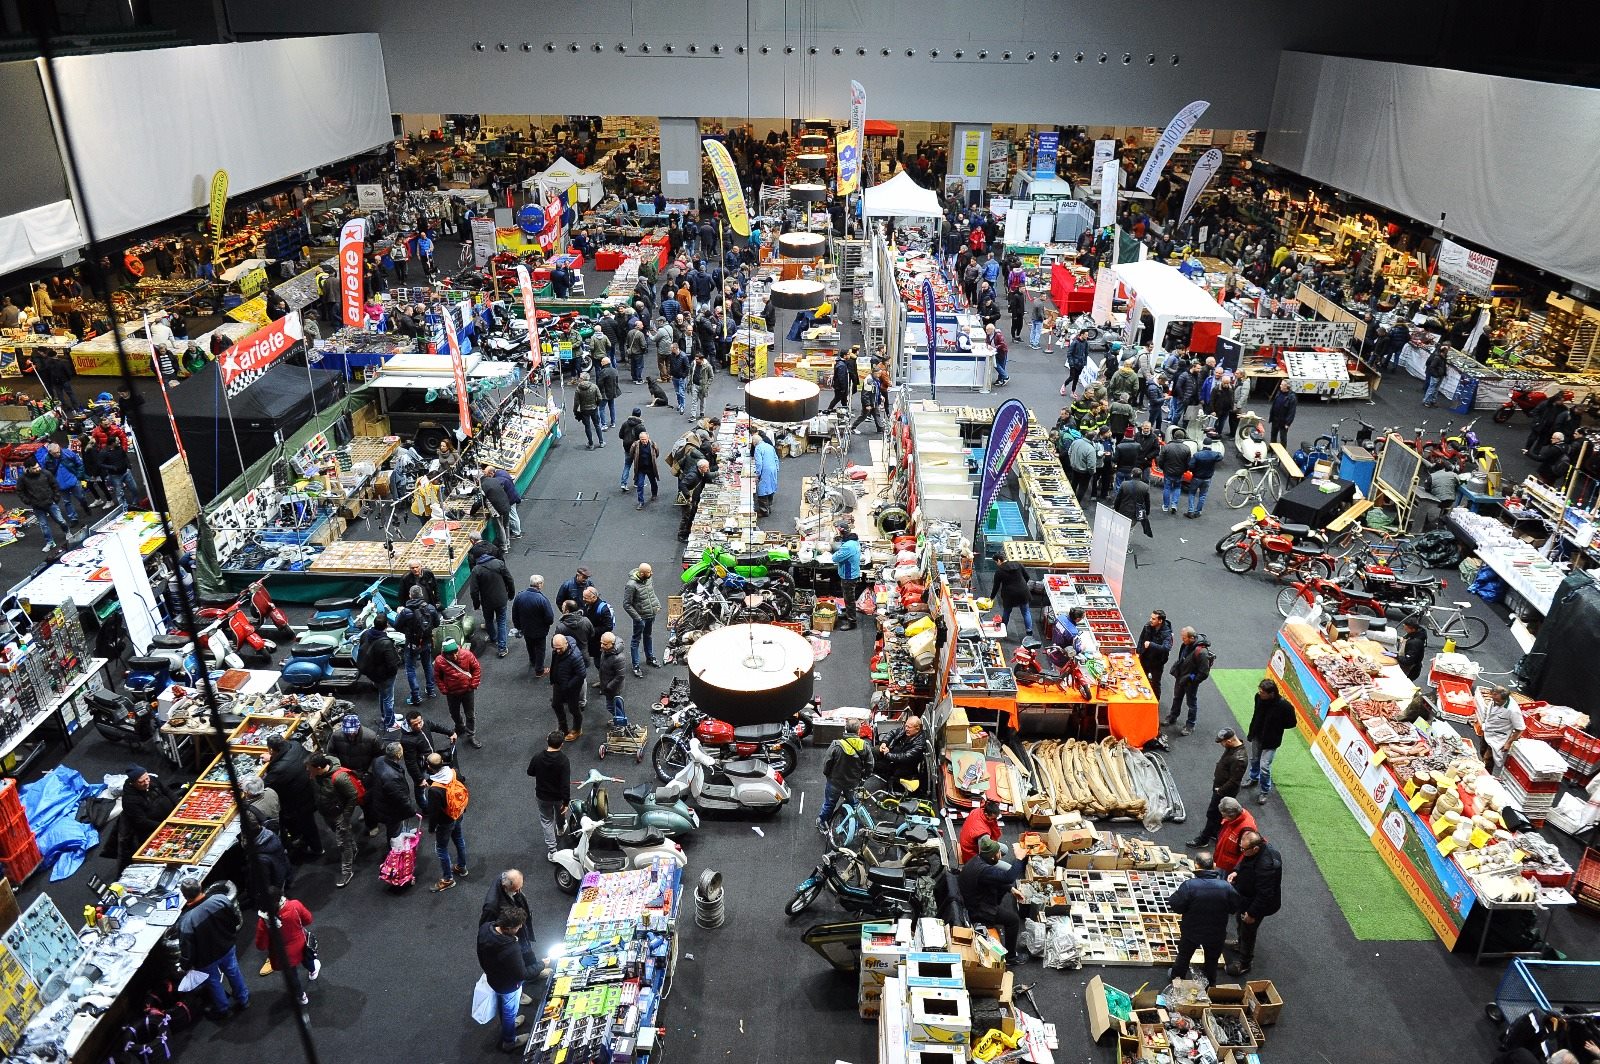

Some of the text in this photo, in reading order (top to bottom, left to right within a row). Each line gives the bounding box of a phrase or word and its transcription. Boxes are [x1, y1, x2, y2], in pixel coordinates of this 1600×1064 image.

[1140, 118, 1187, 189] Pianeta MOTO
[344, 250, 360, 323] ariete
[1468, 250, 1496, 271] MARMITTE
[77, 356, 98, 367] Outlet
[239, 330, 285, 370] ariete
[1321, 734, 1329, 747] da
[1329, 746, 1354, 784] NORCIA
[1353, 784, 1366, 798] per
[1366, 798, 1379, 816] voi
[1378, 837, 1388, 850] da
[1389, 849, 1421, 896] NORCIA
[1421, 898, 1436, 915] per
[1436, 917, 1450, 935] voi
[865, 959, 889, 968] fyffes
